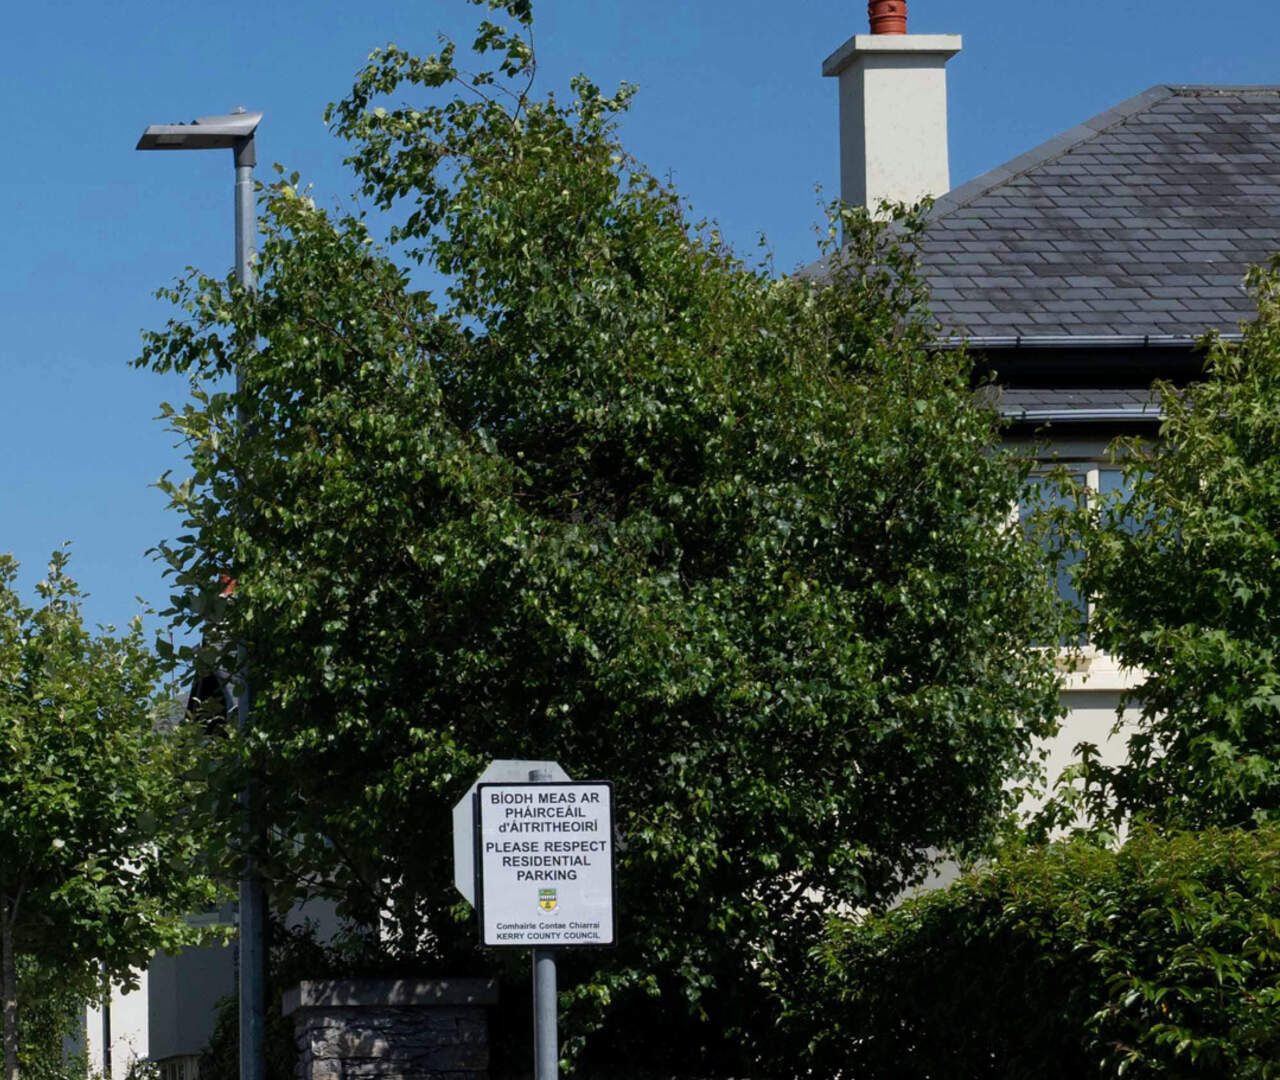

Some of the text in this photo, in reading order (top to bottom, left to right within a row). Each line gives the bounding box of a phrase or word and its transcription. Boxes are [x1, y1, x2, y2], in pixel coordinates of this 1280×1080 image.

[491, 791, 600, 804] BÍODH MEAS AR
[505, 805, 586, 818] PHÁIRCEÁIL
[498, 819, 598, 833] d'ÁITRITHEOIRÍ
[486, 841, 607, 853] PLEASE RESPECT
[502, 855, 591, 867] RESIDENTIAL
[517, 870, 577, 881] PARKING
[496, 922, 536, 930] Comhairle
[539, 922, 566, 930] Contae
[527, 932, 561, 940] COUNTY
[564, 932, 600, 940] COUNCIL
